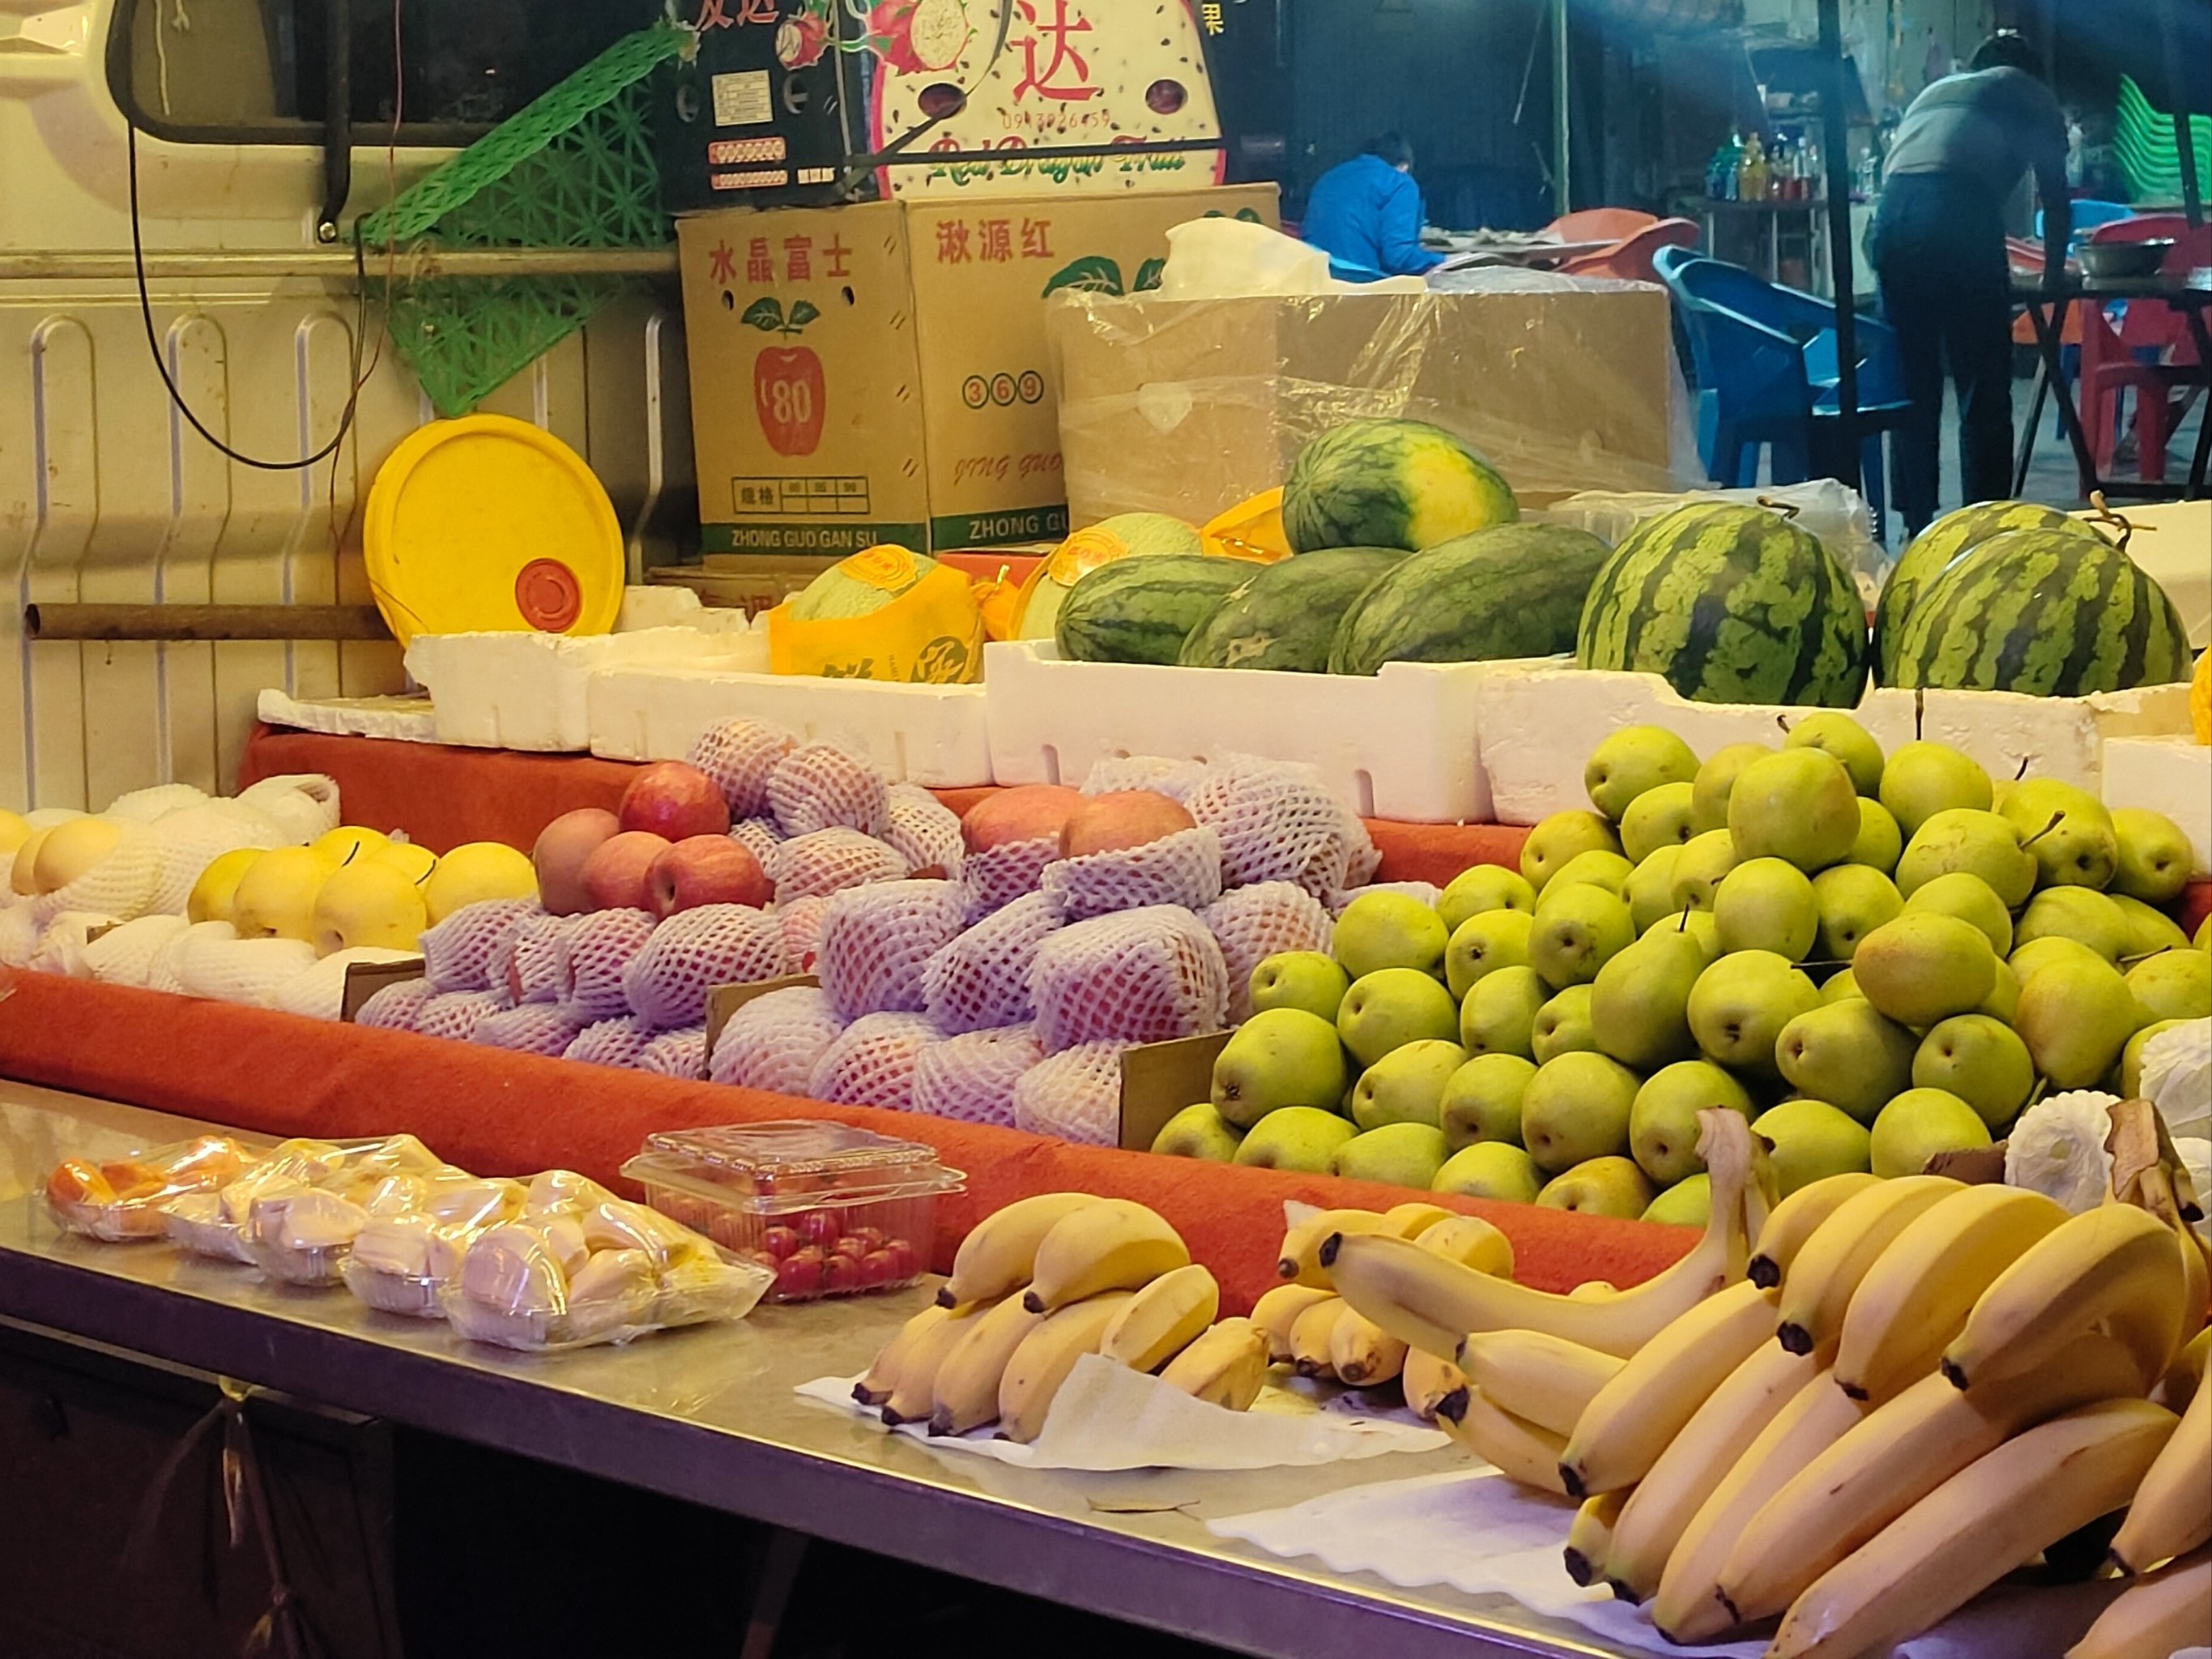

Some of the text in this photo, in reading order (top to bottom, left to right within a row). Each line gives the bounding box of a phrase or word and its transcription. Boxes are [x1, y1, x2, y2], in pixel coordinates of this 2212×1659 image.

[1010, 0, 1100, 104] 达
[709, 232, 852, 284] 水晶富士
[731, 529, 877, 548] ZHONG GUO GAN SU
[969, 514, 1039, 539] ZHONG
